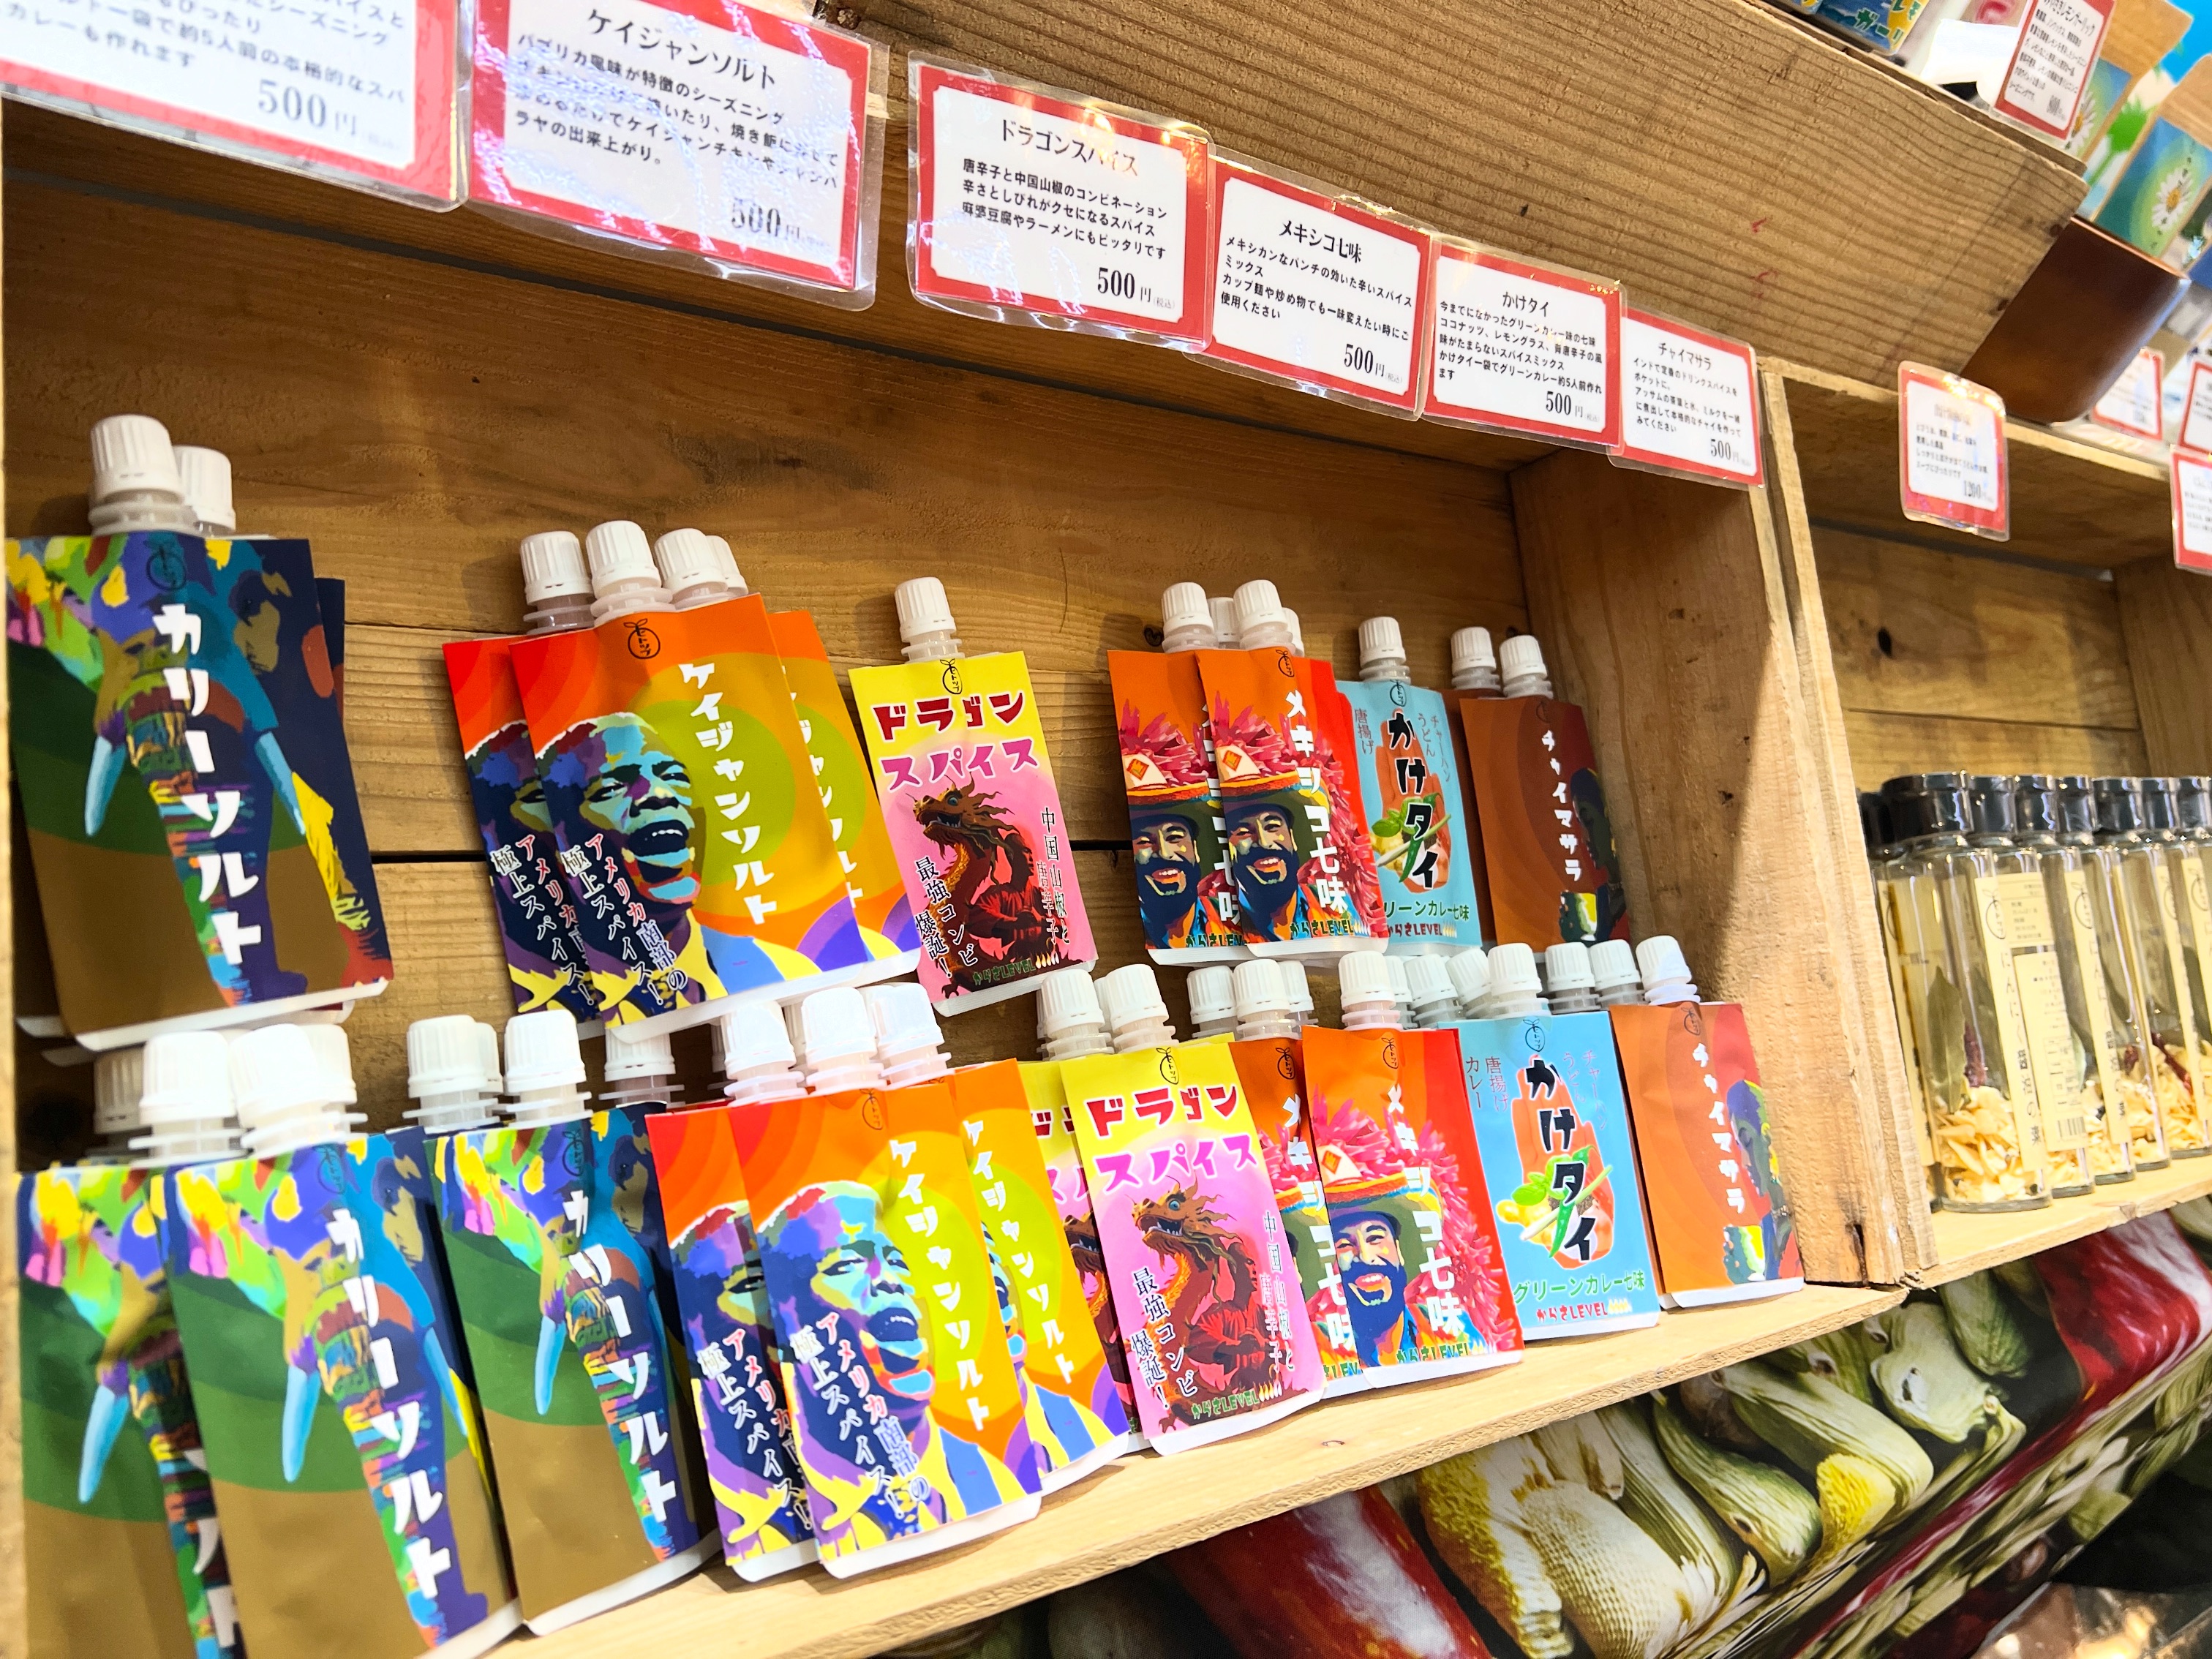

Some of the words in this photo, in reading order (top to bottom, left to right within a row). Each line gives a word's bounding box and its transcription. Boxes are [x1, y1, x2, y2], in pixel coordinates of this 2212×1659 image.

[586, 9, 776, 91] ケイジャンソルト
[516, 110, 661, 165] ラヤの出来上がり。
[1002, 119, 1139, 177] ドラゴンスパイス
[963, 158, 1167, 219] 唐辛子と中国山椒のコンビネーション
[963, 179, 1156, 237] 辛さとしびれがクセになるスパイス
[962, 201, 1166, 260] 麻婆豆腐やラーメンにもピッタリです
[1279, 220, 1362, 263] メキシコ七味
[1225, 254, 1264, 277] ミックス
[1226, 236, 1412, 308] メキシカンなパンチの効いた辛いスパイス
[1220, 290, 1280, 319] 使用ください
[1222, 273, 1409, 341] カップ麺や炒め物でも一味変えたい時にご
[1502, 290, 1549, 317] かけタイ
[1438, 367, 1456, 380] ます
[1439, 334, 1565, 371] 味がたまらないスパイスミックス
[1658, 342, 1712, 372] チャイマサラ
[1636, 415, 1677, 433] みてください
[872, 690, 1026, 743] ドラゴン
[1353, 707, 1374, 755] 唐揚げ
[1418, 712, 1436, 758] うどん
[1429, 714, 1451, 783] チャーハン
[152, 603, 262, 965] カリーソルト
[678, 662, 777, 925] ケイジャンソルト
[880, 737, 1039, 794] スパイス
[1284, 688, 1349, 916] メキシコ七味
[1387, 711, 1439, 890] かけタイ
[1540, 729, 1582, 883] チャイマサラ
[1036, 861, 1058, 945] 唐辛子
[1041, 807, 1071, 945] 中国山椒と
[586, 832, 688, 990] アメリカ南部の
[914, 856, 979, 967] 最強コンビ
[1085, 1084, 1239, 1138] ドラゴン
[1465, 1056, 1483, 1110] カレー
[1485, 1056, 1510, 1113] 唐揚げ
[1562, 1051, 1587, 1104] うどん
[1581, 1049, 1607, 1130] チャーハン
[1524, 1057, 1598, 1263] かけタイ
[1692, 1043, 1745, 1214] チャイマサラ
[1094, 1133, 1260, 1196] スパイス
[1387, 1084, 1464, 1337] メキシコ七味
[888, 1139, 990, 1432] ケイジャンソルト
[962, 1120, 1075, 1384] ケイジャンソルト
[1263, 1211, 1295, 1373] 中国山椒と
[1513, 1269, 1647, 1306] グリーンカレー七味
[563, 1189, 677, 1522] カリーソルト
[1132, 1266, 1198, 1398] 最強コンビ
[1259, 1273, 1284, 1372] 唐辛子
[325, 1208, 452, 1599] カリーソルト
[816, 1311, 932, 1501] アメリカ南部の
